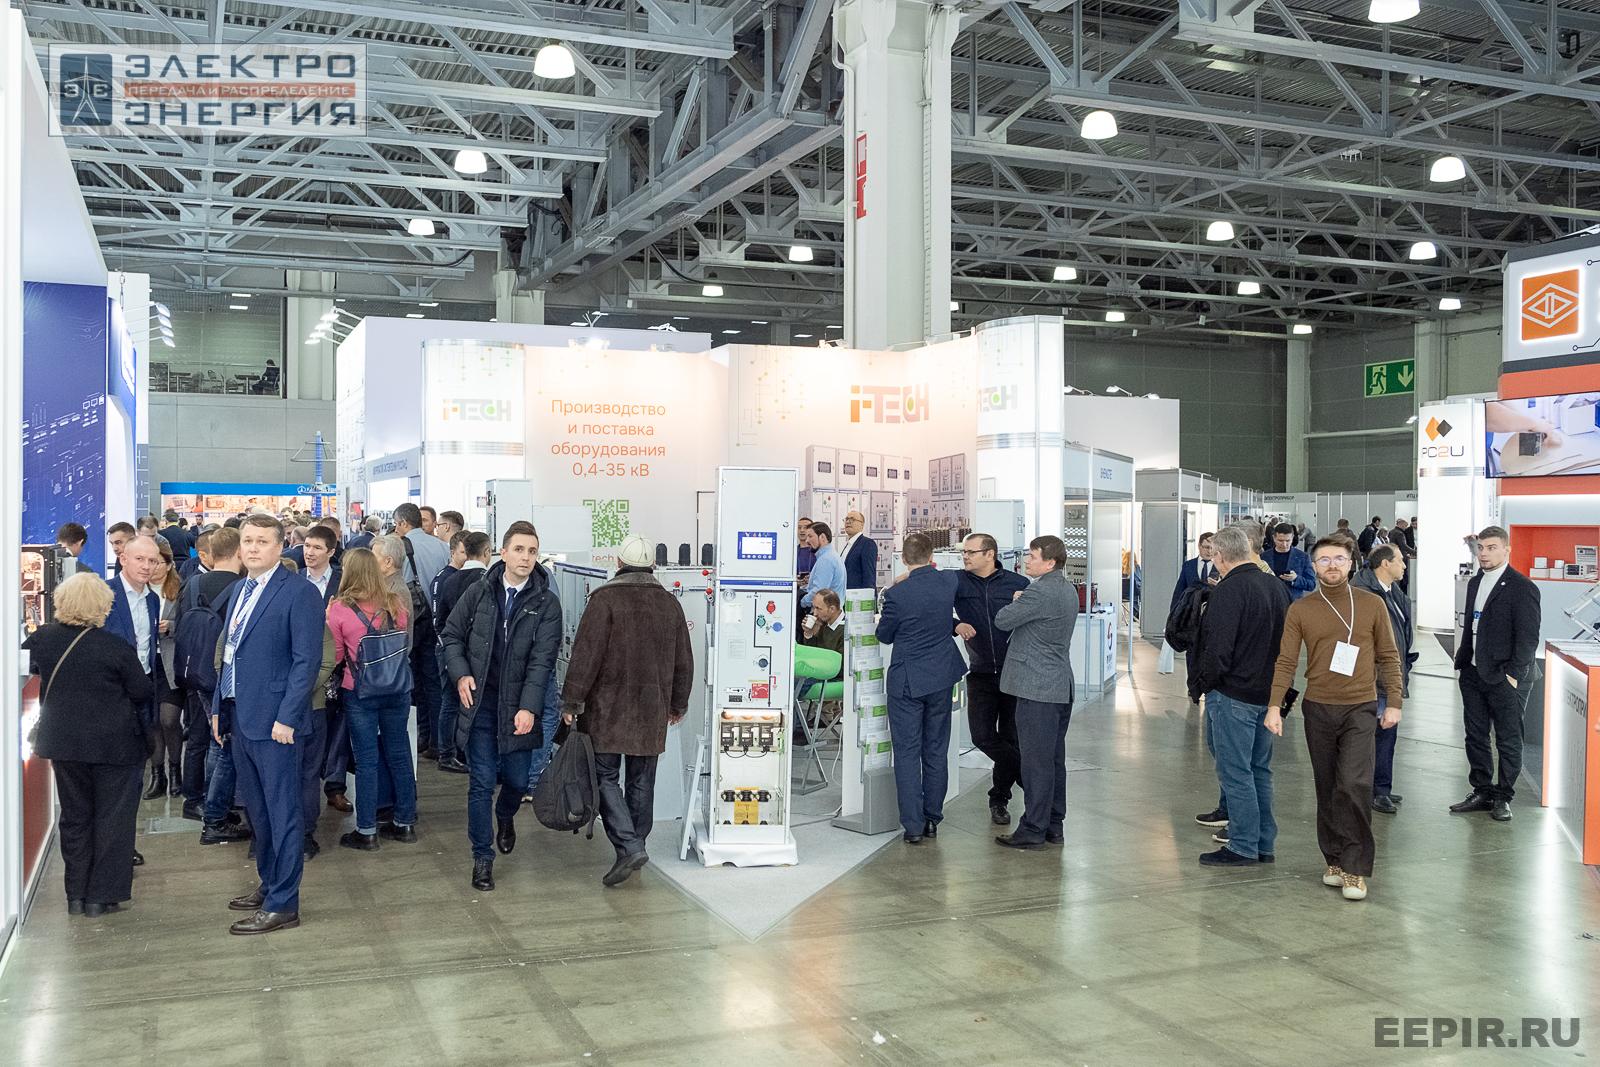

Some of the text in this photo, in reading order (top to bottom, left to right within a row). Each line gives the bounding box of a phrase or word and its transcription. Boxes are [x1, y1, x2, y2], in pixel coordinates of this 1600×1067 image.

[551, 399, 666, 417] Производство
[568, 424, 655, 436] и поставка
[551, 441, 666, 459] оборудования
[572, 462, 650, 478] 0,4-35 кВ
